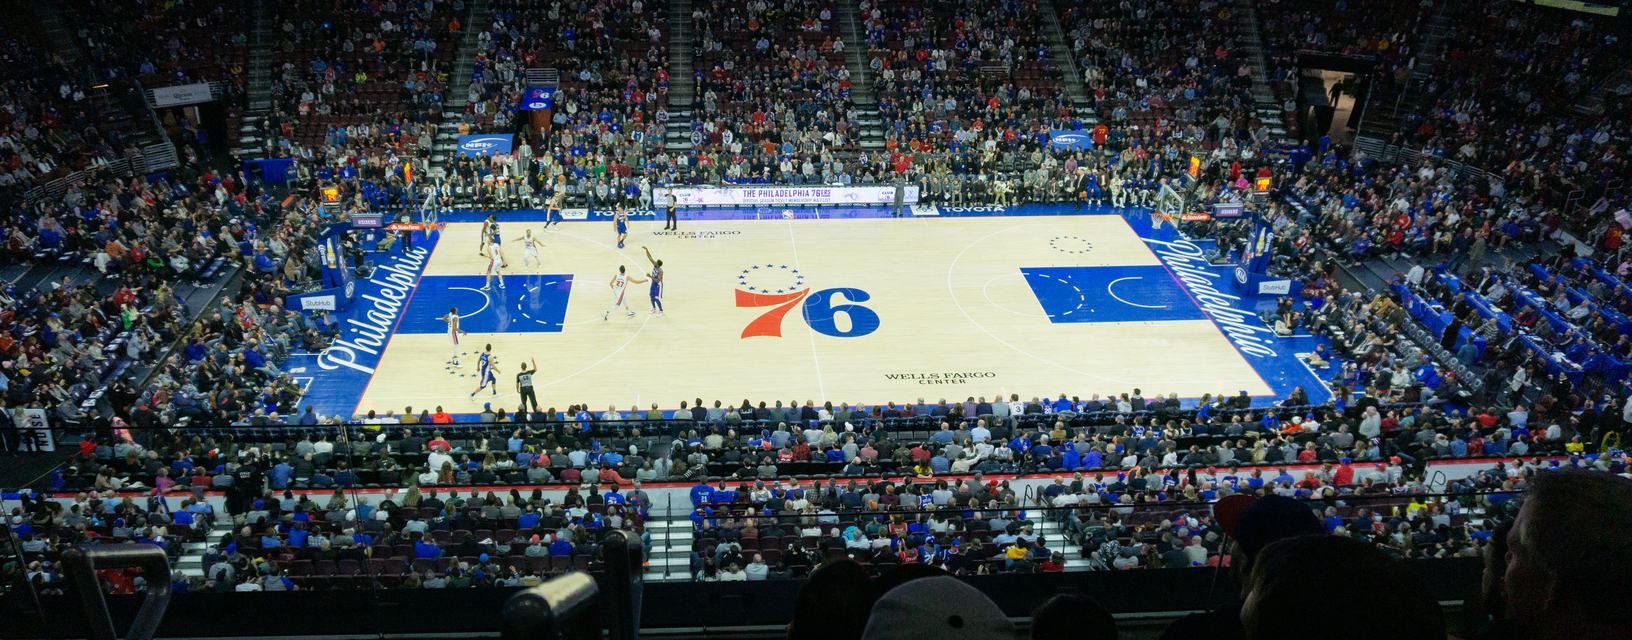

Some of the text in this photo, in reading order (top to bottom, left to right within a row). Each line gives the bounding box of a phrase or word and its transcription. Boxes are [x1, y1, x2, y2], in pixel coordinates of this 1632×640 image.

[743, 189, 756, 197] THE
[758, 189, 810, 197] PHILADELPHIA
[317, 246, 428, 374] Philadelphia
[735, 288, 880, 340] 76
